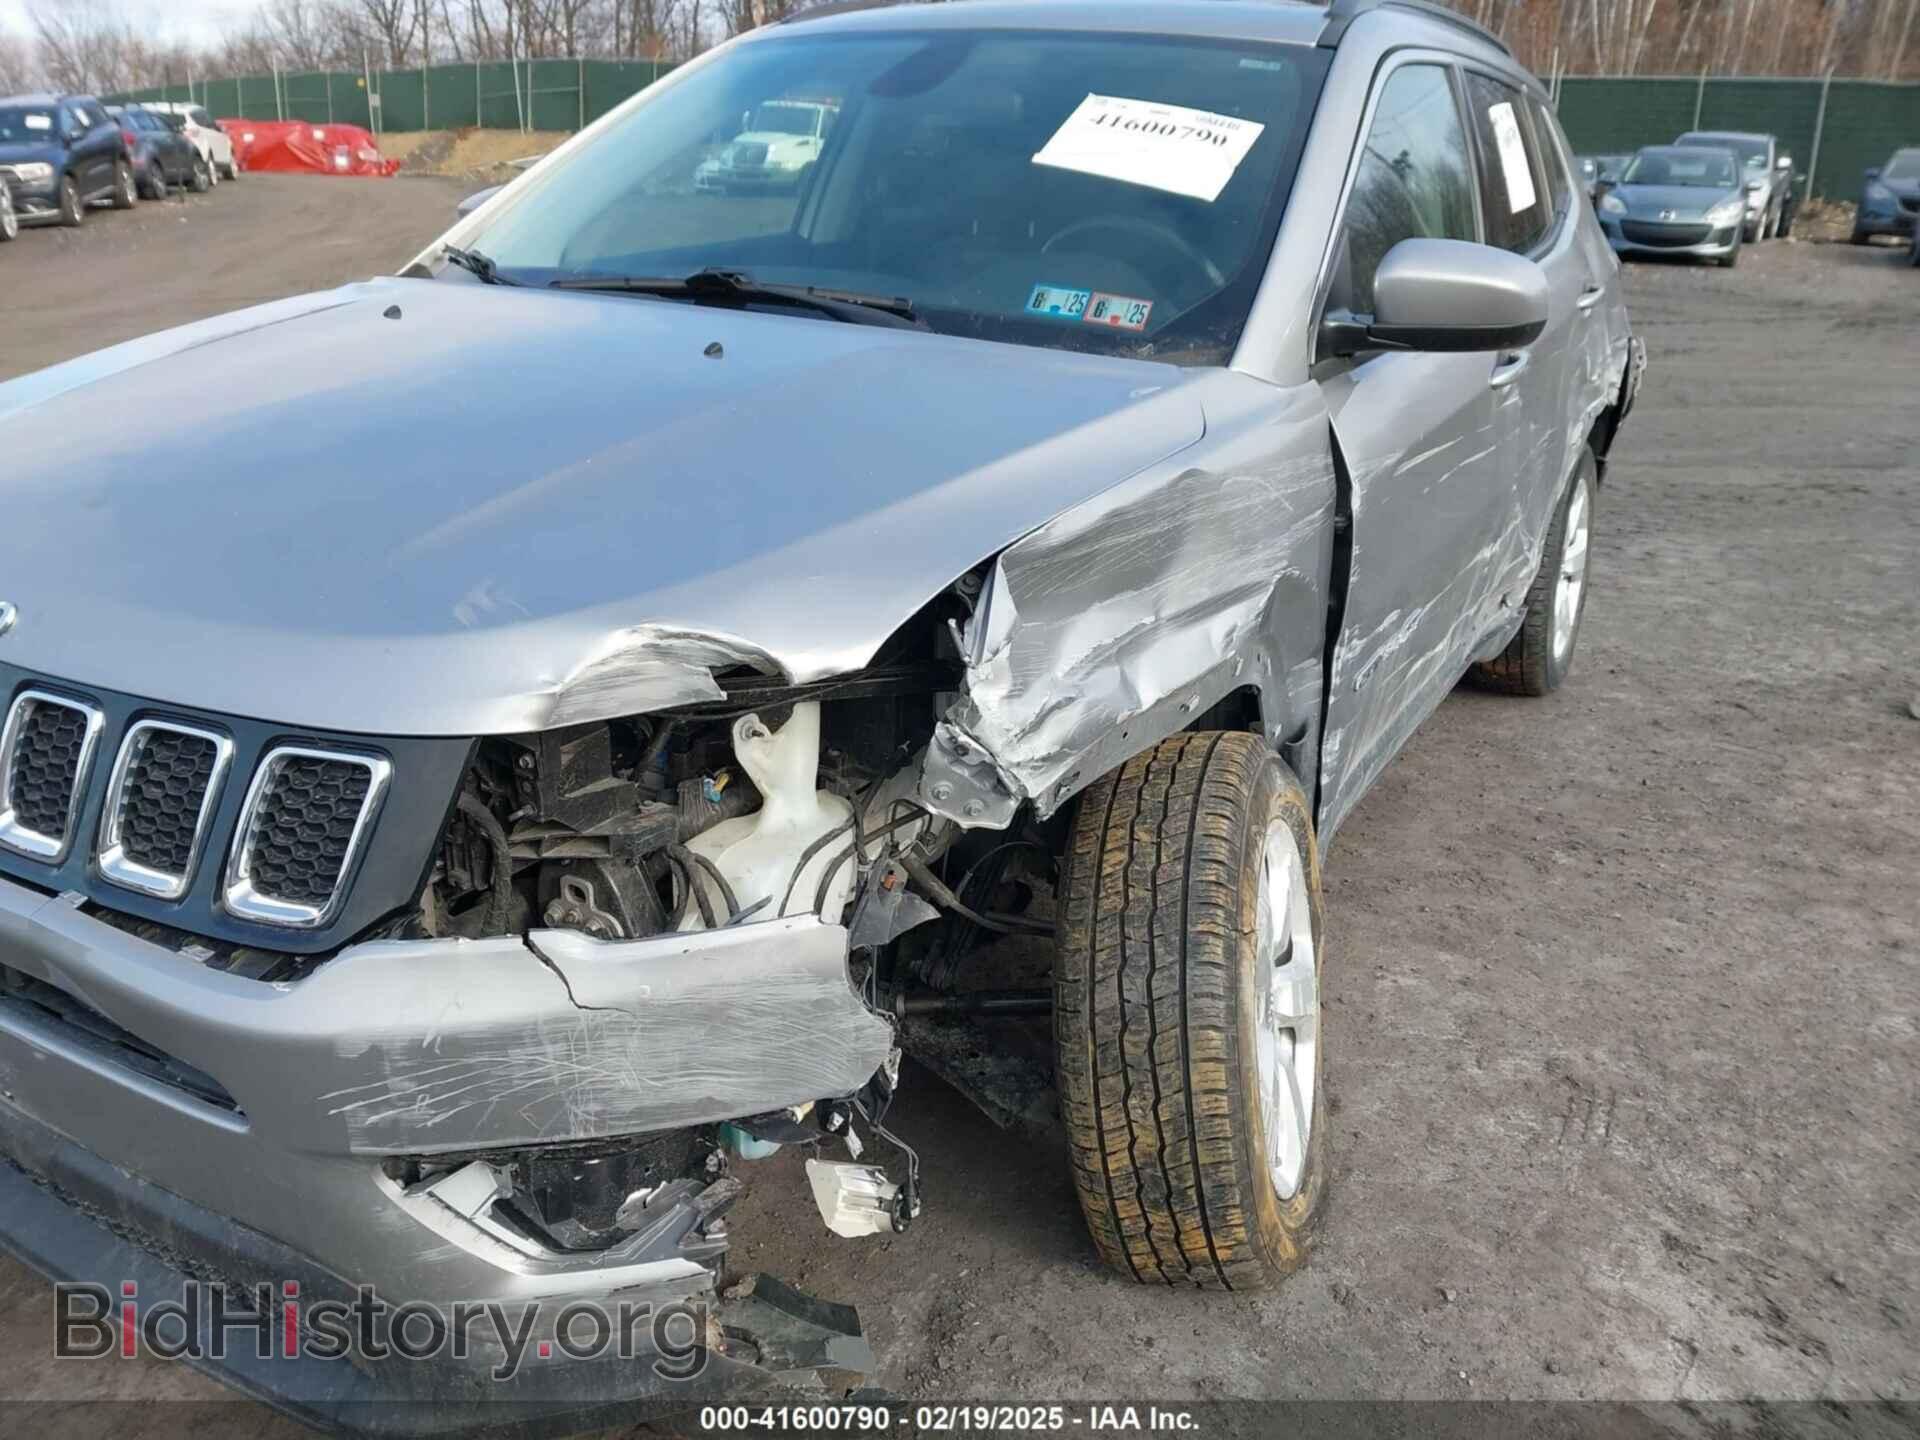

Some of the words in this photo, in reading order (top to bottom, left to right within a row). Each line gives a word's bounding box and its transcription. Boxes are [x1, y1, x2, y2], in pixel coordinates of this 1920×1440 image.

[1089, 112, 1228, 147] 41600790
[1068, 294, 1087, 314] 25
[1129, 303, 1148, 324] 25
